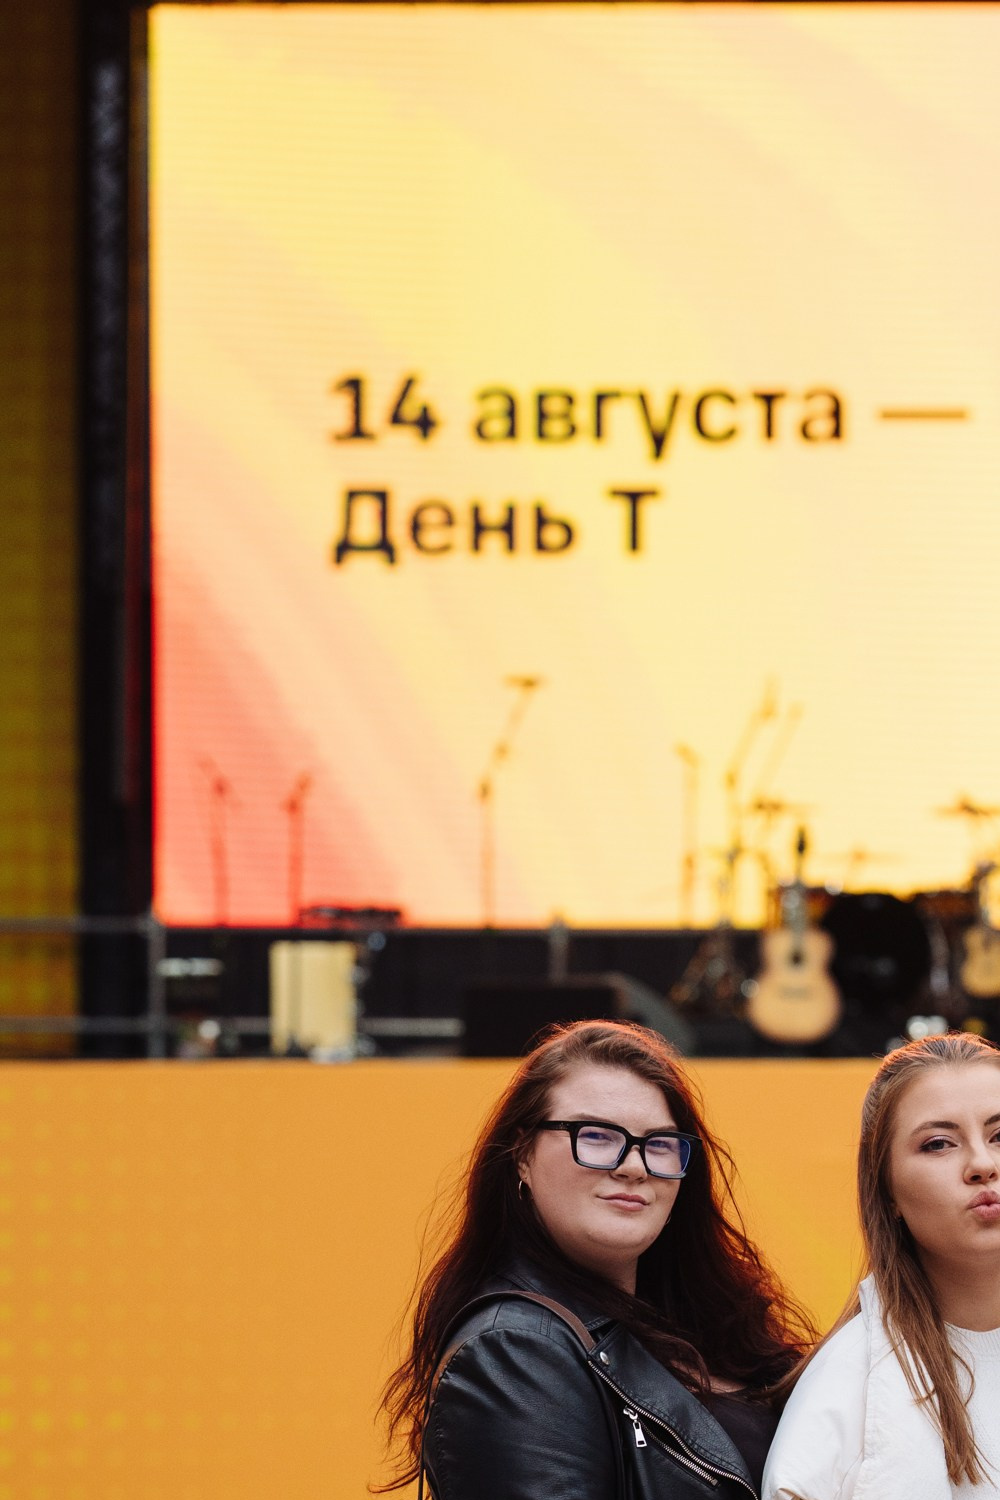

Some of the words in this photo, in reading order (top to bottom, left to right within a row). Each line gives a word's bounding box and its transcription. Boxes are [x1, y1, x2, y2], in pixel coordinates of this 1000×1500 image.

[333, 375, 439, 443] 14
[472, 387, 846, 463] августа
[331, 487, 576, 568] День
[607, 486, 661, 556] Т
